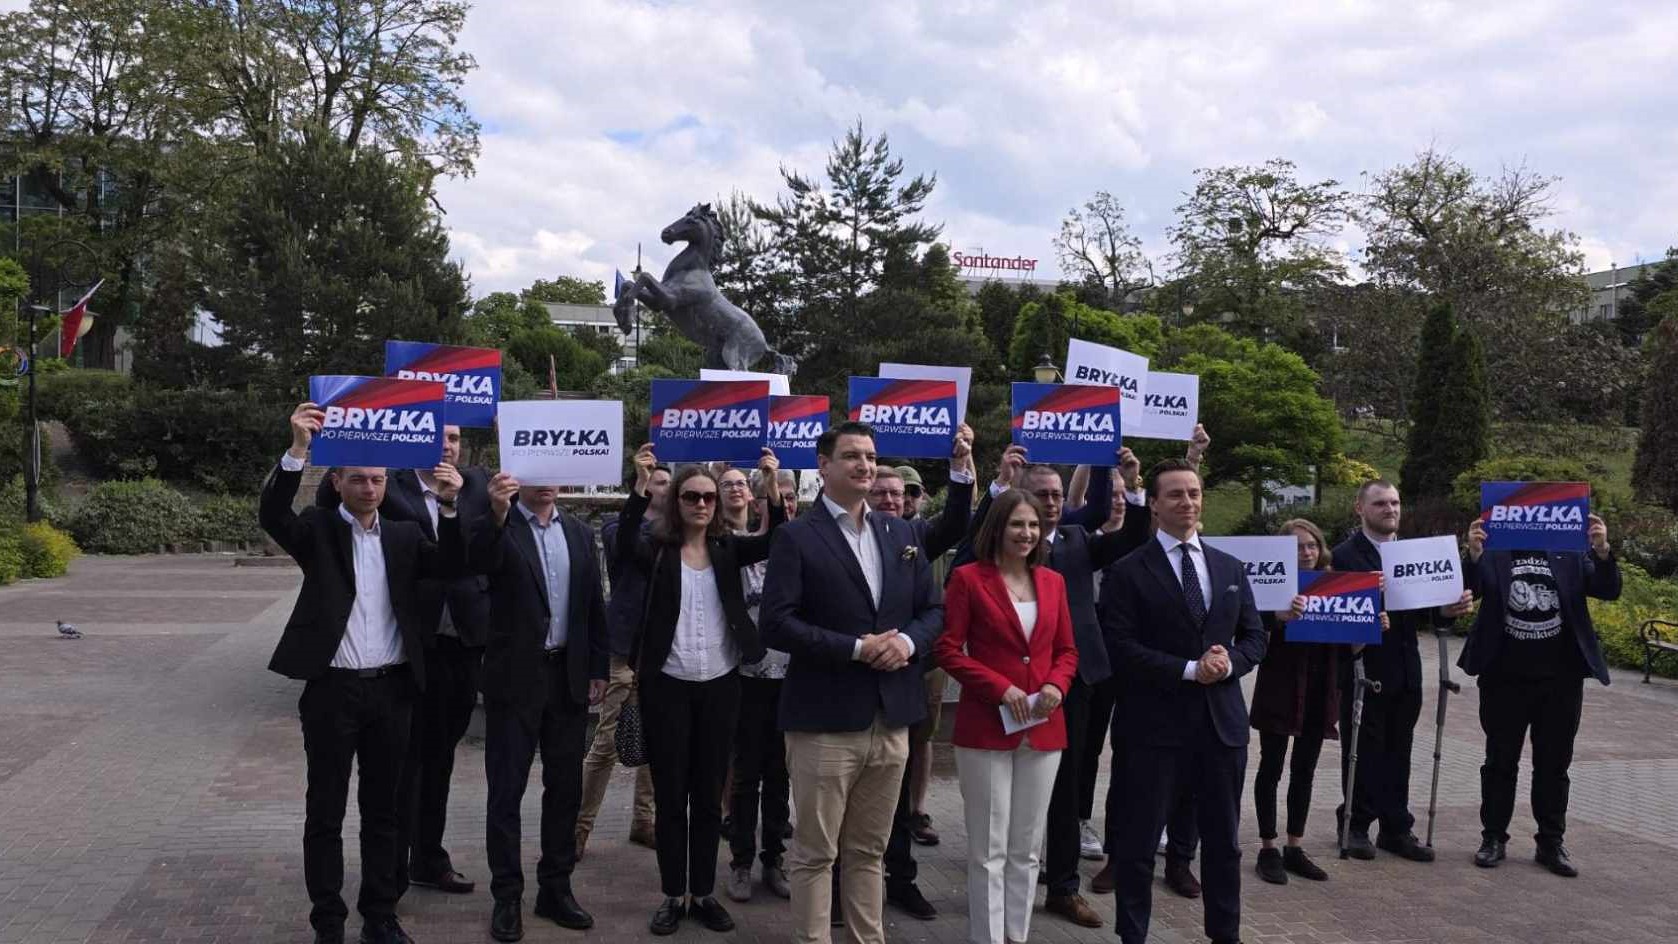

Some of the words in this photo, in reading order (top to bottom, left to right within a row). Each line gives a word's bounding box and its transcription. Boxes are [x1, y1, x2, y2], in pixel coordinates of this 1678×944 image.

[953, 251, 1038, 270] Santander
[1075, 365, 1138, 393] BRYŁKA
[455, 395, 493, 404] POLSKA!
[1143, 393, 1188, 409] YŁKA
[323, 406, 436, 432] BRYŁKA
[661, 409, 761, 429] BRYŁKA
[859, 404, 951, 425] BRYŁKA
[1022, 410, 1115, 432] BRYŁKA
[320, 430, 336, 440] PO
[338, 431, 390, 441] PIERWSZE
[391, 433, 435, 443] POLSKA!
[513, 429, 610, 447] BRYŁKA
[660, 430, 673, 439] PO
[674, 430, 720, 439] PIERWSZE
[721, 430, 760, 439] POLSKA!
[767, 420, 823, 439] YŁKA
[914, 426, 951, 435] POLSKA!
[1021, 431, 1034, 440] PO
[1035, 431, 1077, 441] PIERWSZE
[1078, 433, 1115, 442] POLSKA!
[572, 448, 609, 456] POLSKA!
[792, 440, 817, 449] POLSK
[1491, 505, 1583, 523] BRYŁKA
[1503, 522, 1544, 530] PIERWSZE
[1393, 559, 1454, 578] BRYŁKA
[1341, 614, 1375, 623] POLSKA!
